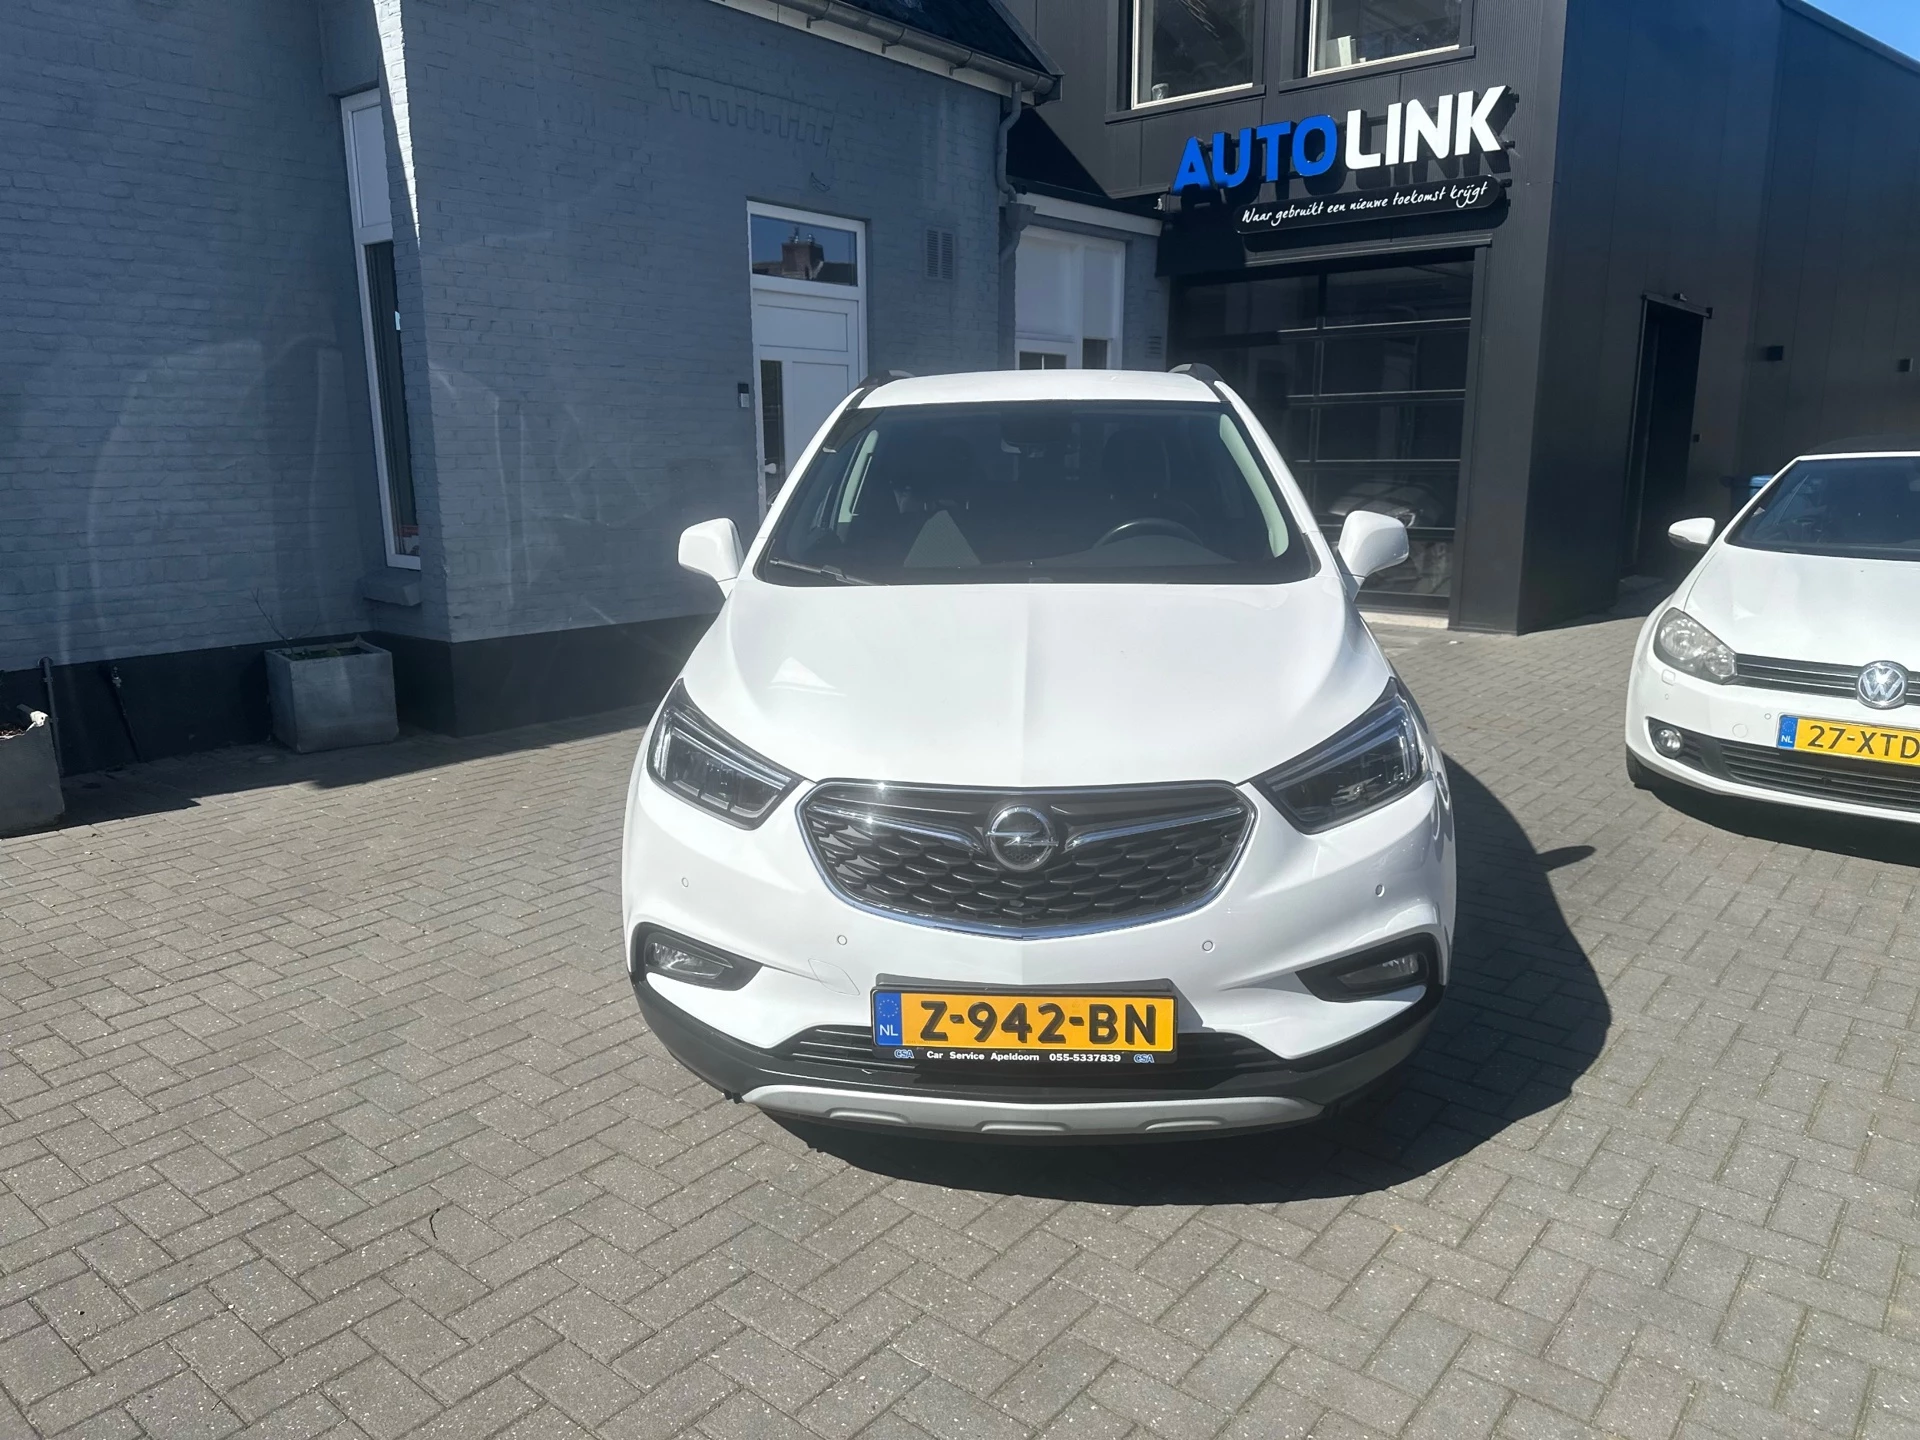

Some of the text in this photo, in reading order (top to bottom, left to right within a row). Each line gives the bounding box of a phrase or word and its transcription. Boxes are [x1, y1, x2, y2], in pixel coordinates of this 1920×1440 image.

[1242, 208, 1272, 223] Waar
[1270, 201, 1324, 227] gebruikt
[1327, 203, 1346, 213] een
[1349, 198, 1388, 211] nieuwe
[1392, 186, 1446, 206] toekomst
[1780, 725, 1920, 759] NL 27-XTD
[879, 1000, 1157, 1046] NL Z-942-BN
[893, 1049, 1155, 1064] CSA Car Service Apeldoorn 055-5337839 CSA
